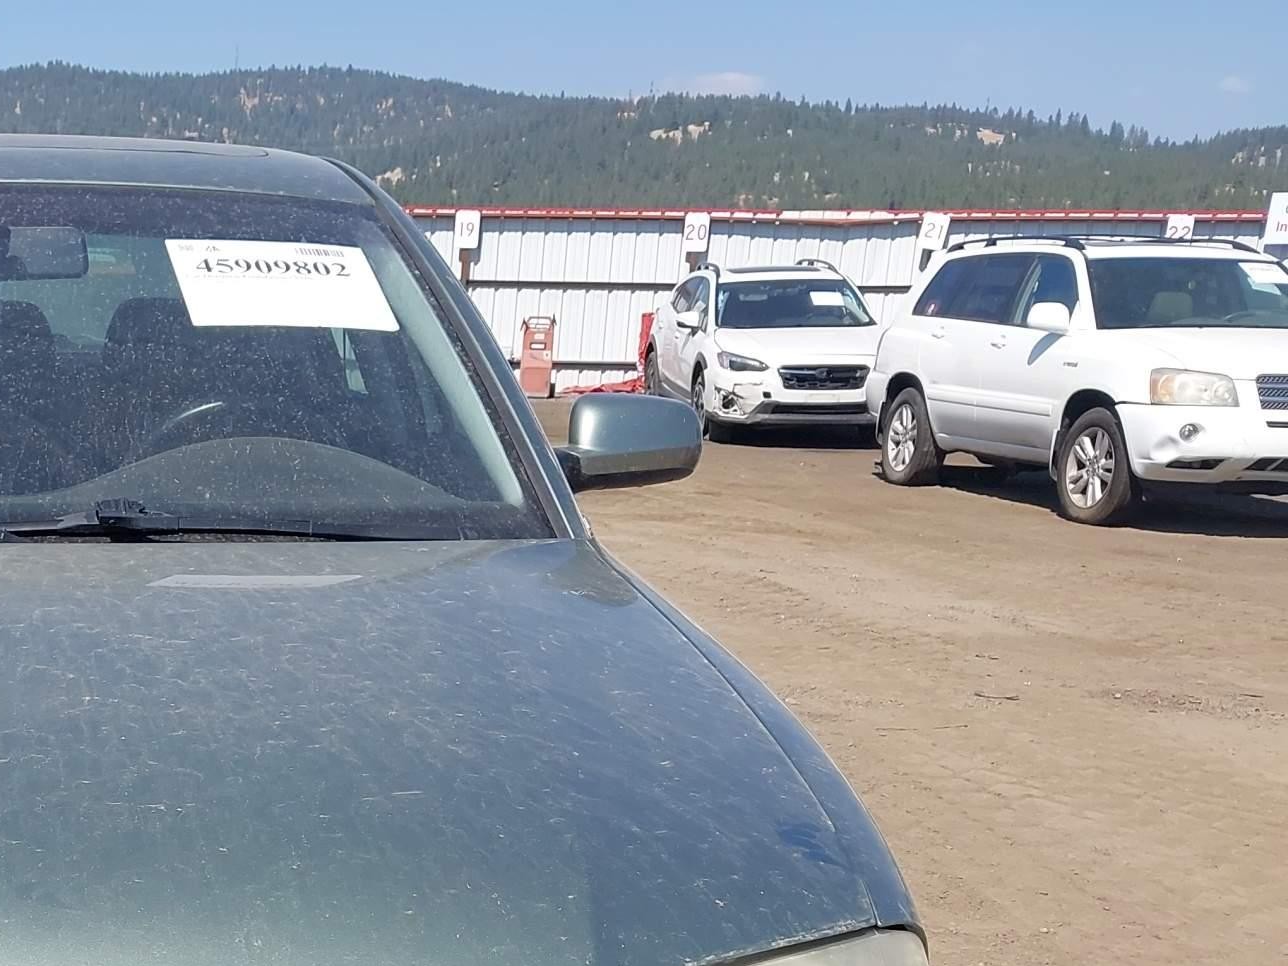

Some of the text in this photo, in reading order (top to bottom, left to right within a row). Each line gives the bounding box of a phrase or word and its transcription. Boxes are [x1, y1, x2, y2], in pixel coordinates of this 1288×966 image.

[460, 222, 475, 237] 19
[685, 223, 707, 241] 20
[924, 222, 943, 240] 21
[1168, 225, 1191, 239] 22
[196, 257, 352, 278] 45909802
